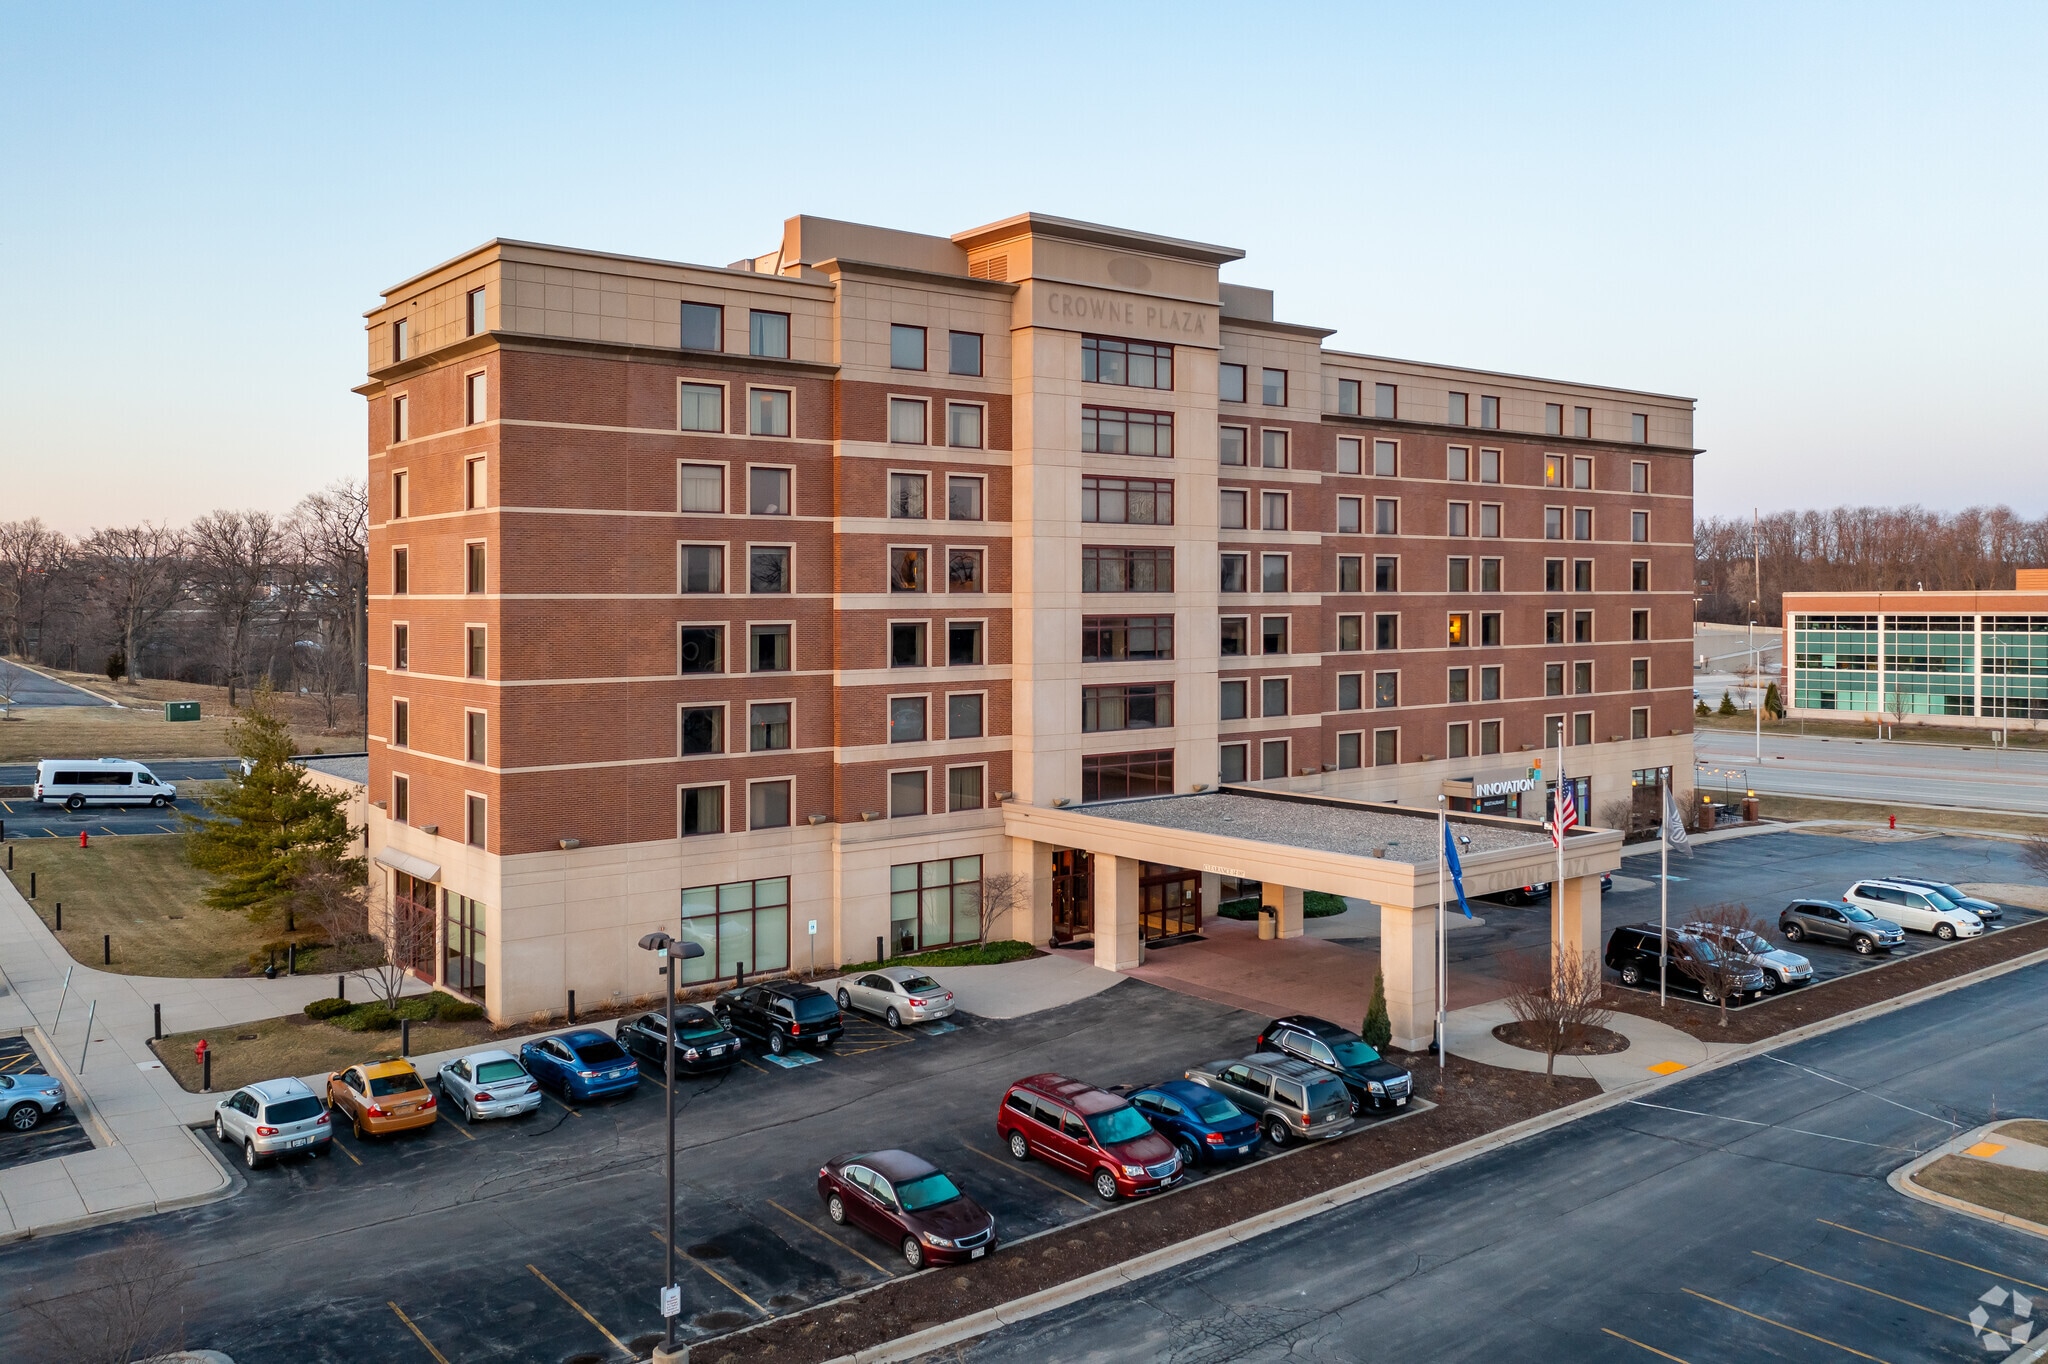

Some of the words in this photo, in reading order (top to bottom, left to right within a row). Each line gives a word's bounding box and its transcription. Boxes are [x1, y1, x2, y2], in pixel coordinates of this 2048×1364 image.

[1048, 292, 1134, 324] CROWNE
[1146, 306, 1206, 335] PLAZA
[1476, 778, 1535, 797] INNOVATION
[1488, 865, 1543, 892] CROWNE
[1551, 858, 1590, 880] PAZA
